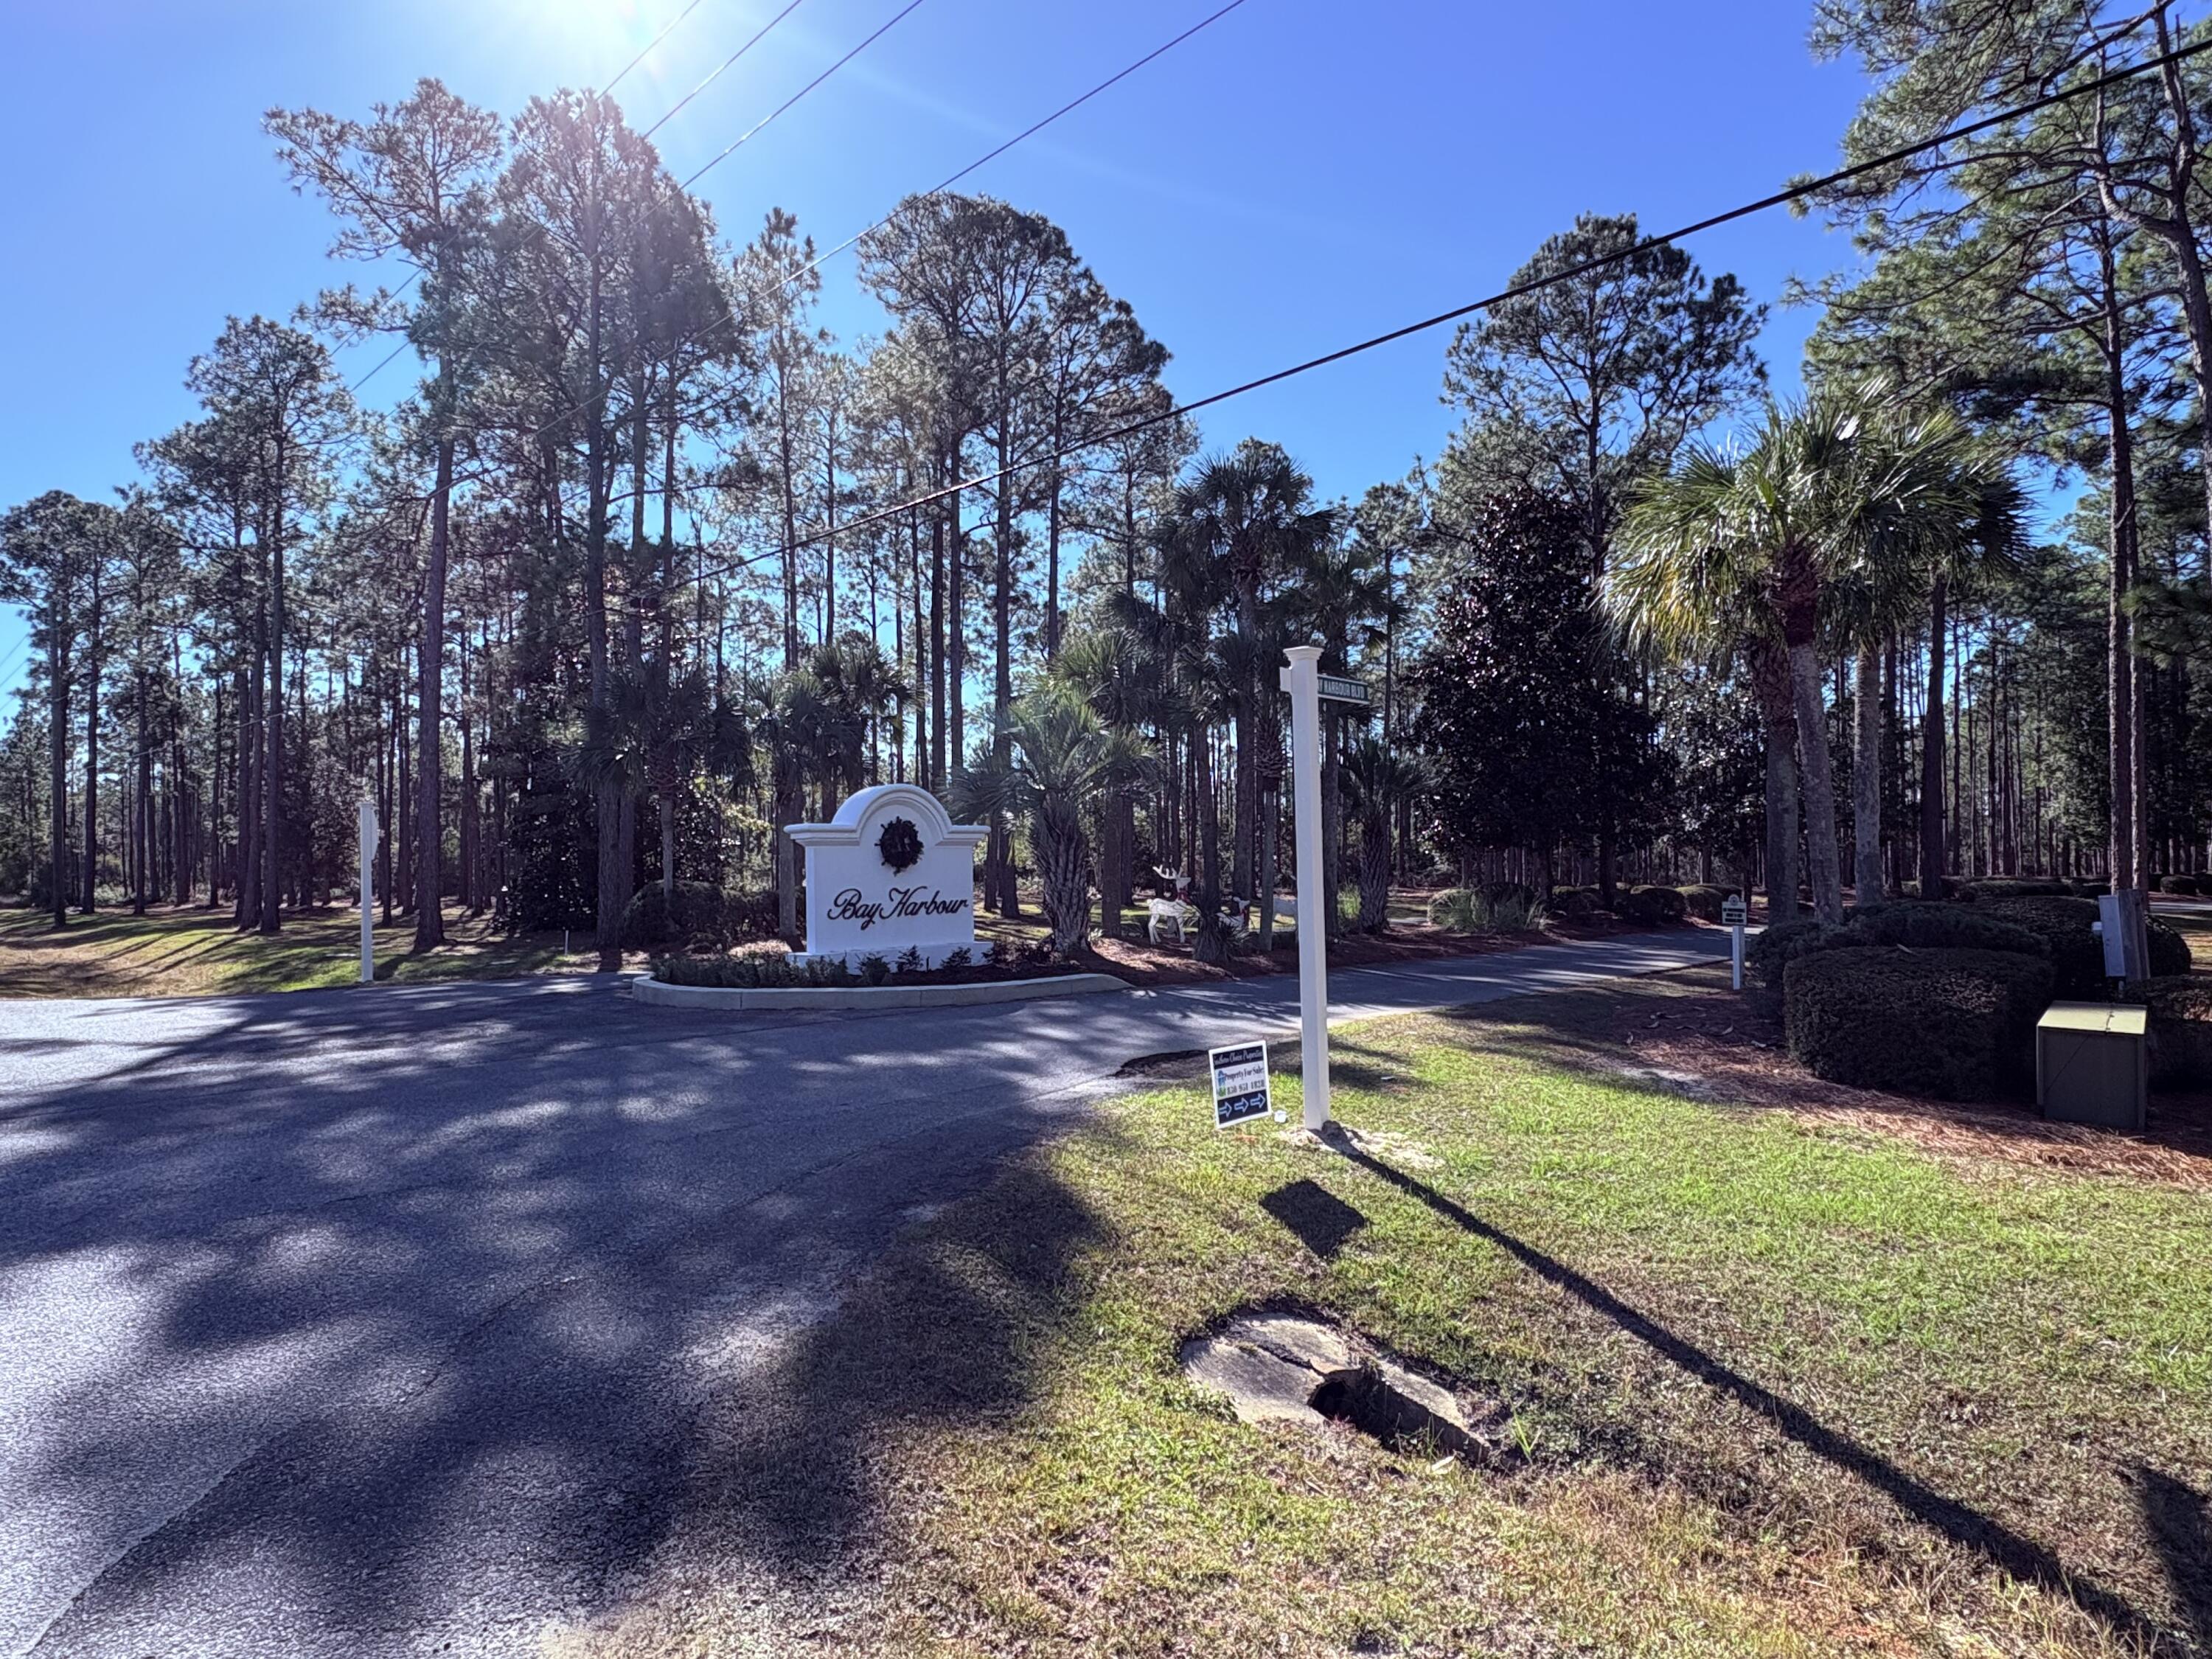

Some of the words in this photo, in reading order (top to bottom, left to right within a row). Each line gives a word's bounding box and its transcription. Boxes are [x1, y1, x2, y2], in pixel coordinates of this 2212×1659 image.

[1324, 680, 1350, 696] HARBOUR
[1351, 684, 1365, 699] BLVD
[827, 888, 880, 931] Bay
[879, 886, 969, 919] Harbour
[1224, 1071, 1244, 1082] Property
[1244, 1068, 1253, 1077] For
[1253, 1065, 1265, 1075] Sale
